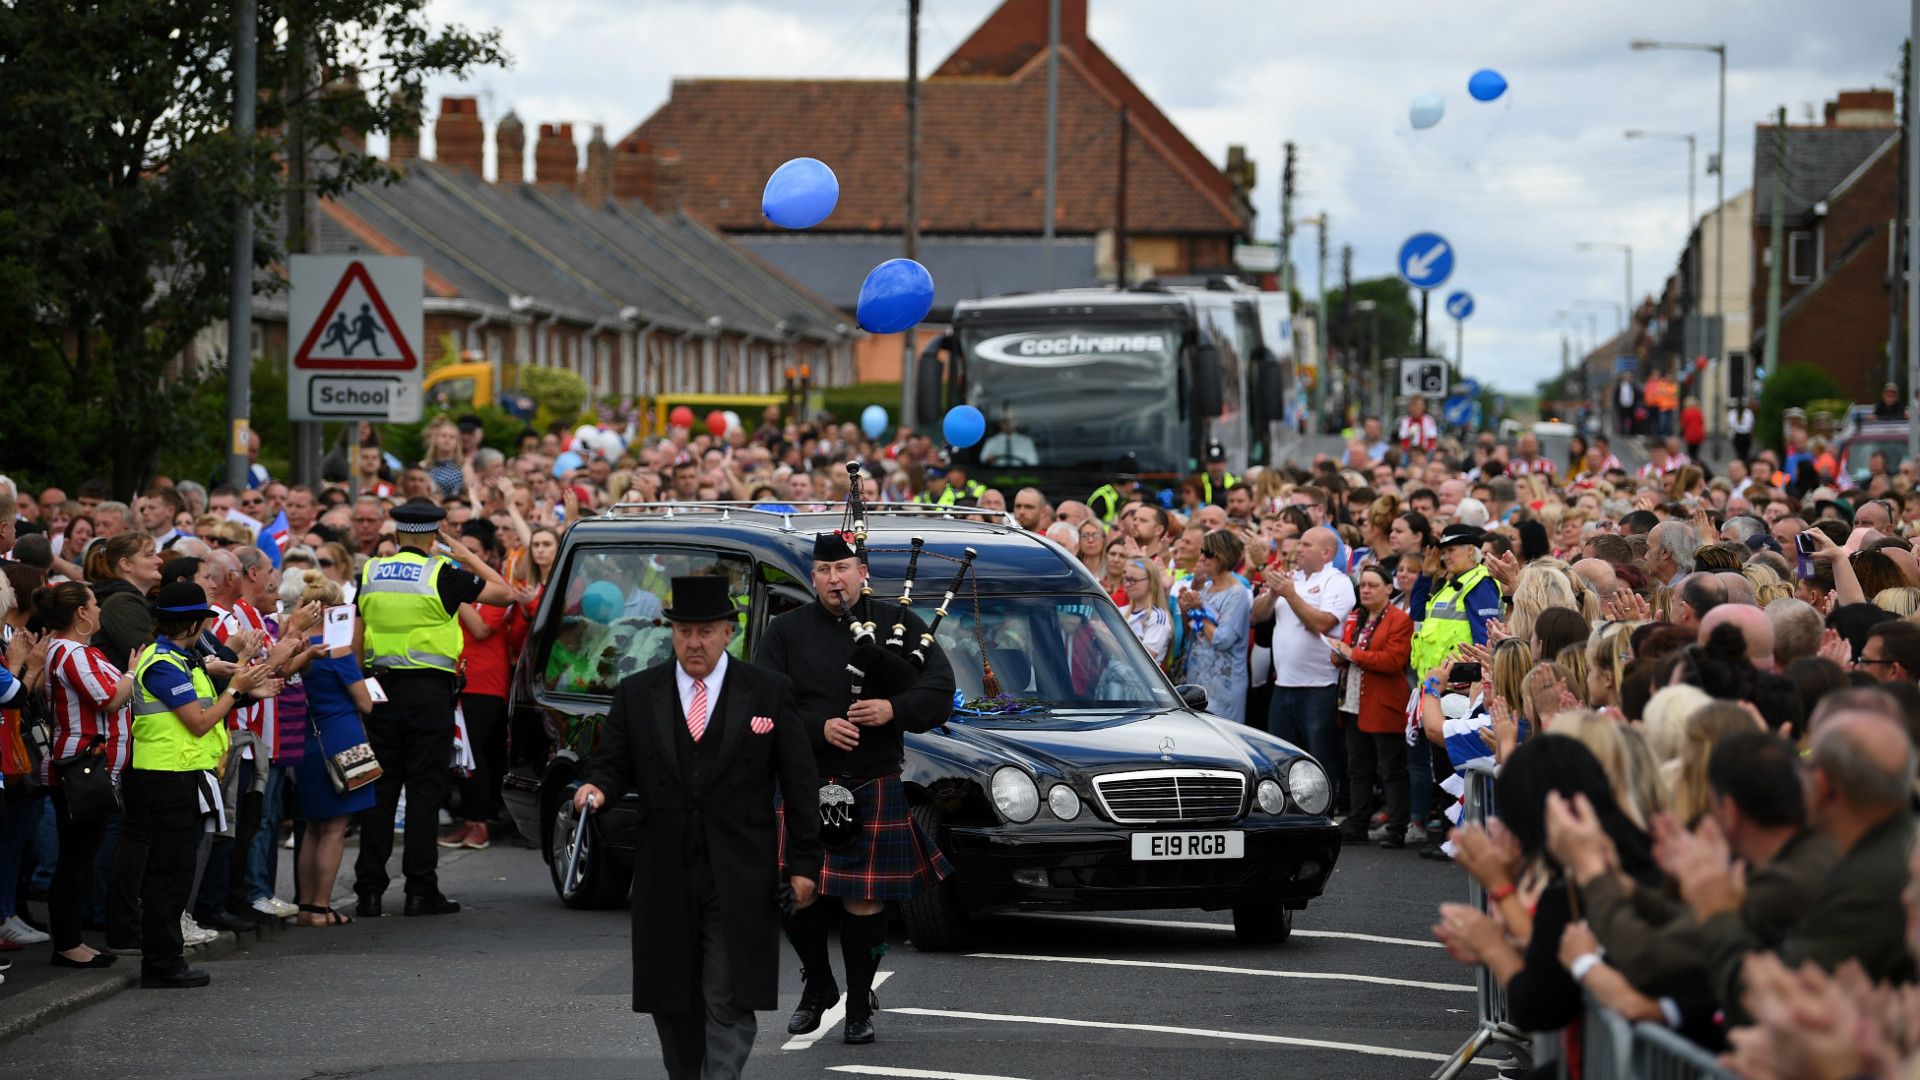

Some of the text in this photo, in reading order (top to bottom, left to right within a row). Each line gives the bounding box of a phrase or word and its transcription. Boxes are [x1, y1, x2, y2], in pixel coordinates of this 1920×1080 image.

[320, 386, 389, 404] School
[375, 564, 420, 579] POLICE
[1151, 835, 1225, 856] E19 RGB
